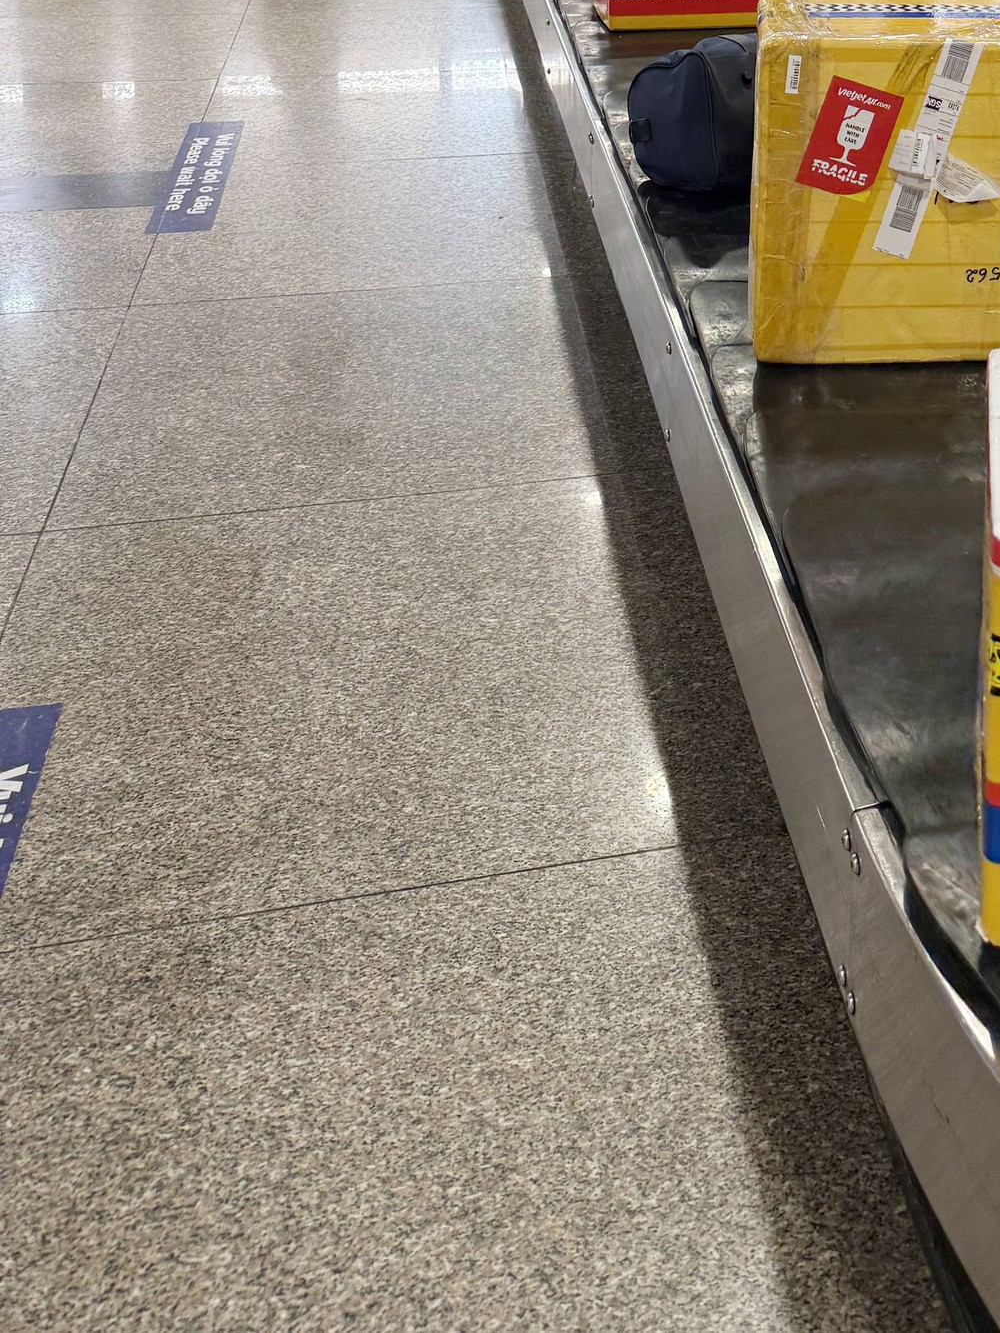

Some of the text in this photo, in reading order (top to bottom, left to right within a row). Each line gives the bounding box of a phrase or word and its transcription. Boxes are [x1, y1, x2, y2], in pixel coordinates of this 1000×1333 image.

[845, 122, 866, 134] HANDLE
[846, 130, 860, 138] WITH
[215, 133, 235, 146] Vui
[844, 137, 857, 145] CARE
[204, 147, 231, 167] lòng
[164, 137, 210, 211] Please wait here
[198, 168, 223, 184] đợi
[811, 158, 868, 186] FRAGILE
[186, 195, 214, 215] đây
